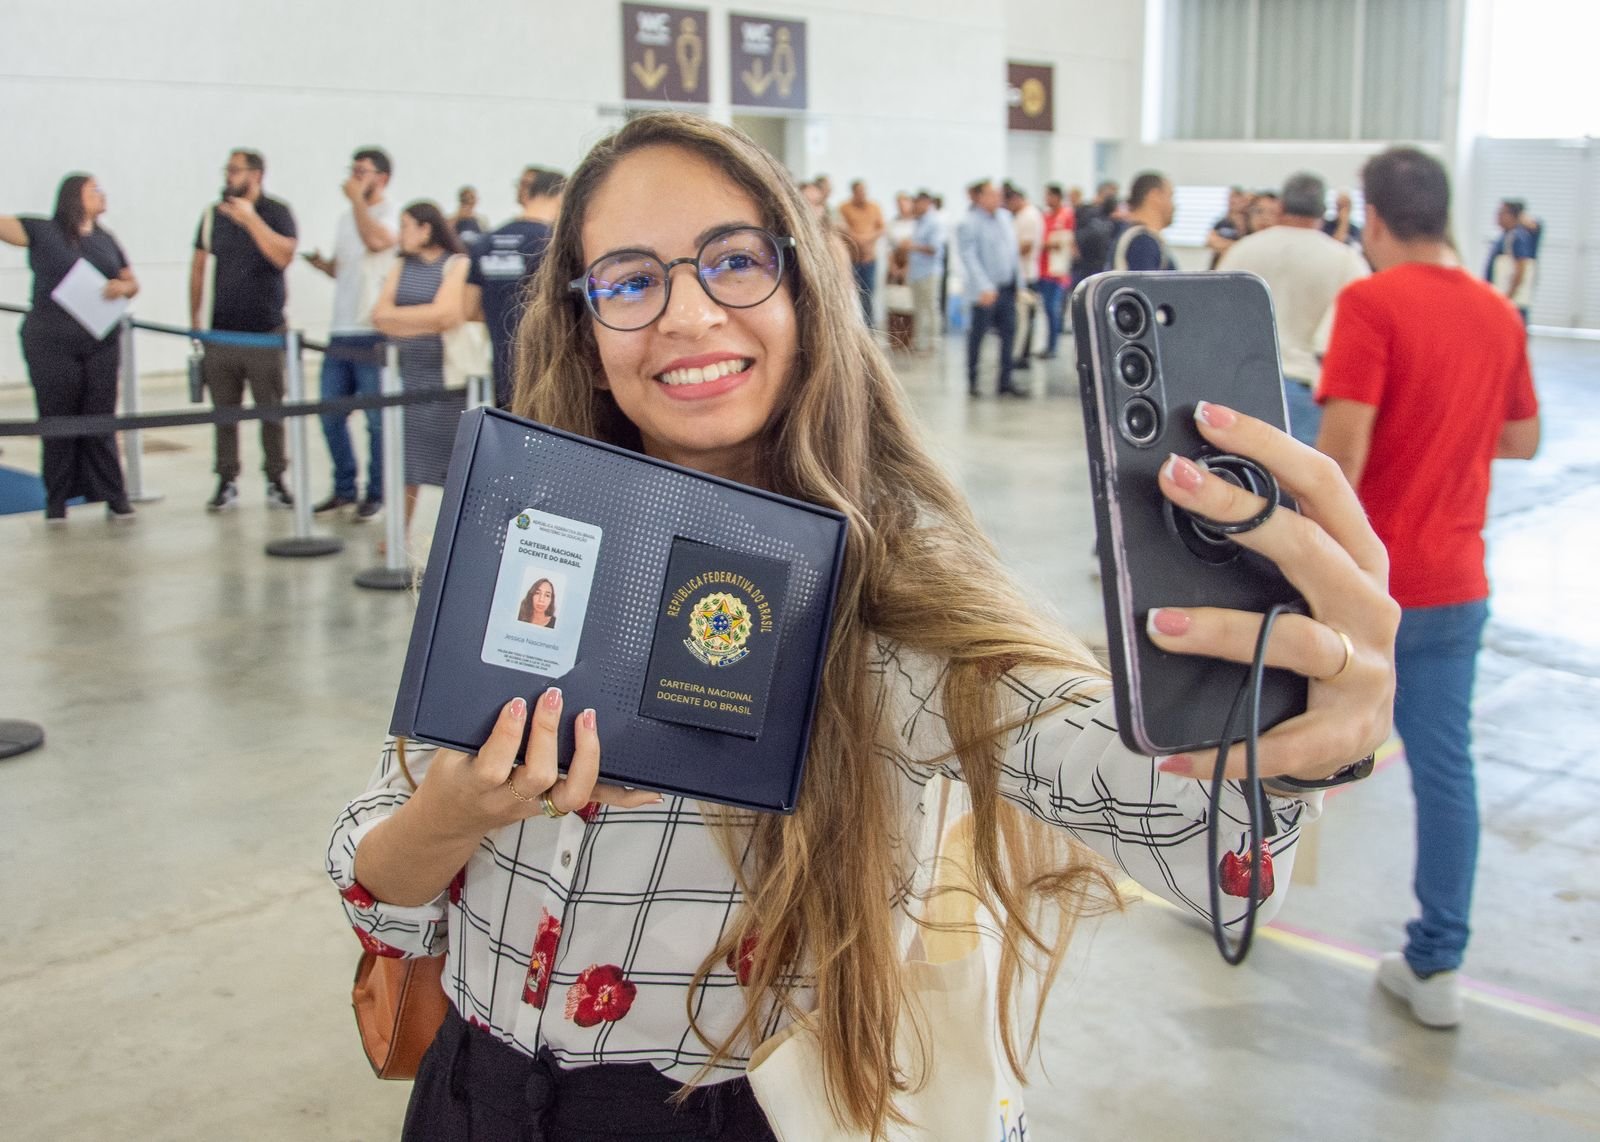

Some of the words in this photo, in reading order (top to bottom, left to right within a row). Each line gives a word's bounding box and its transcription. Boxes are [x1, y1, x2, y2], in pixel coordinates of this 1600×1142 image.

[518, 547, 548, 560] DOCENTE
[549, 554, 559, 562] DO
[559, 557, 581, 568] BRASIL
[520, 539, 550, 552] CARTEIRA
[550, 547, 583, 560] NACIONAL
[702, 571, 755, 594] FEDERATIVA
[667, 576, 704, 617] REPÚBLICA
[750, 589, 765, 603] DO
[757, 602, 773, 633] BRASIL
[660, 678, 705, 694] CARTEIRA
[707, 687, 753, 702] NACIONAL
[656, 691, 701, 706] DOCENTE
[703, 699, 717, 708] DO
[719, 702, 752, 715] BRASIL
